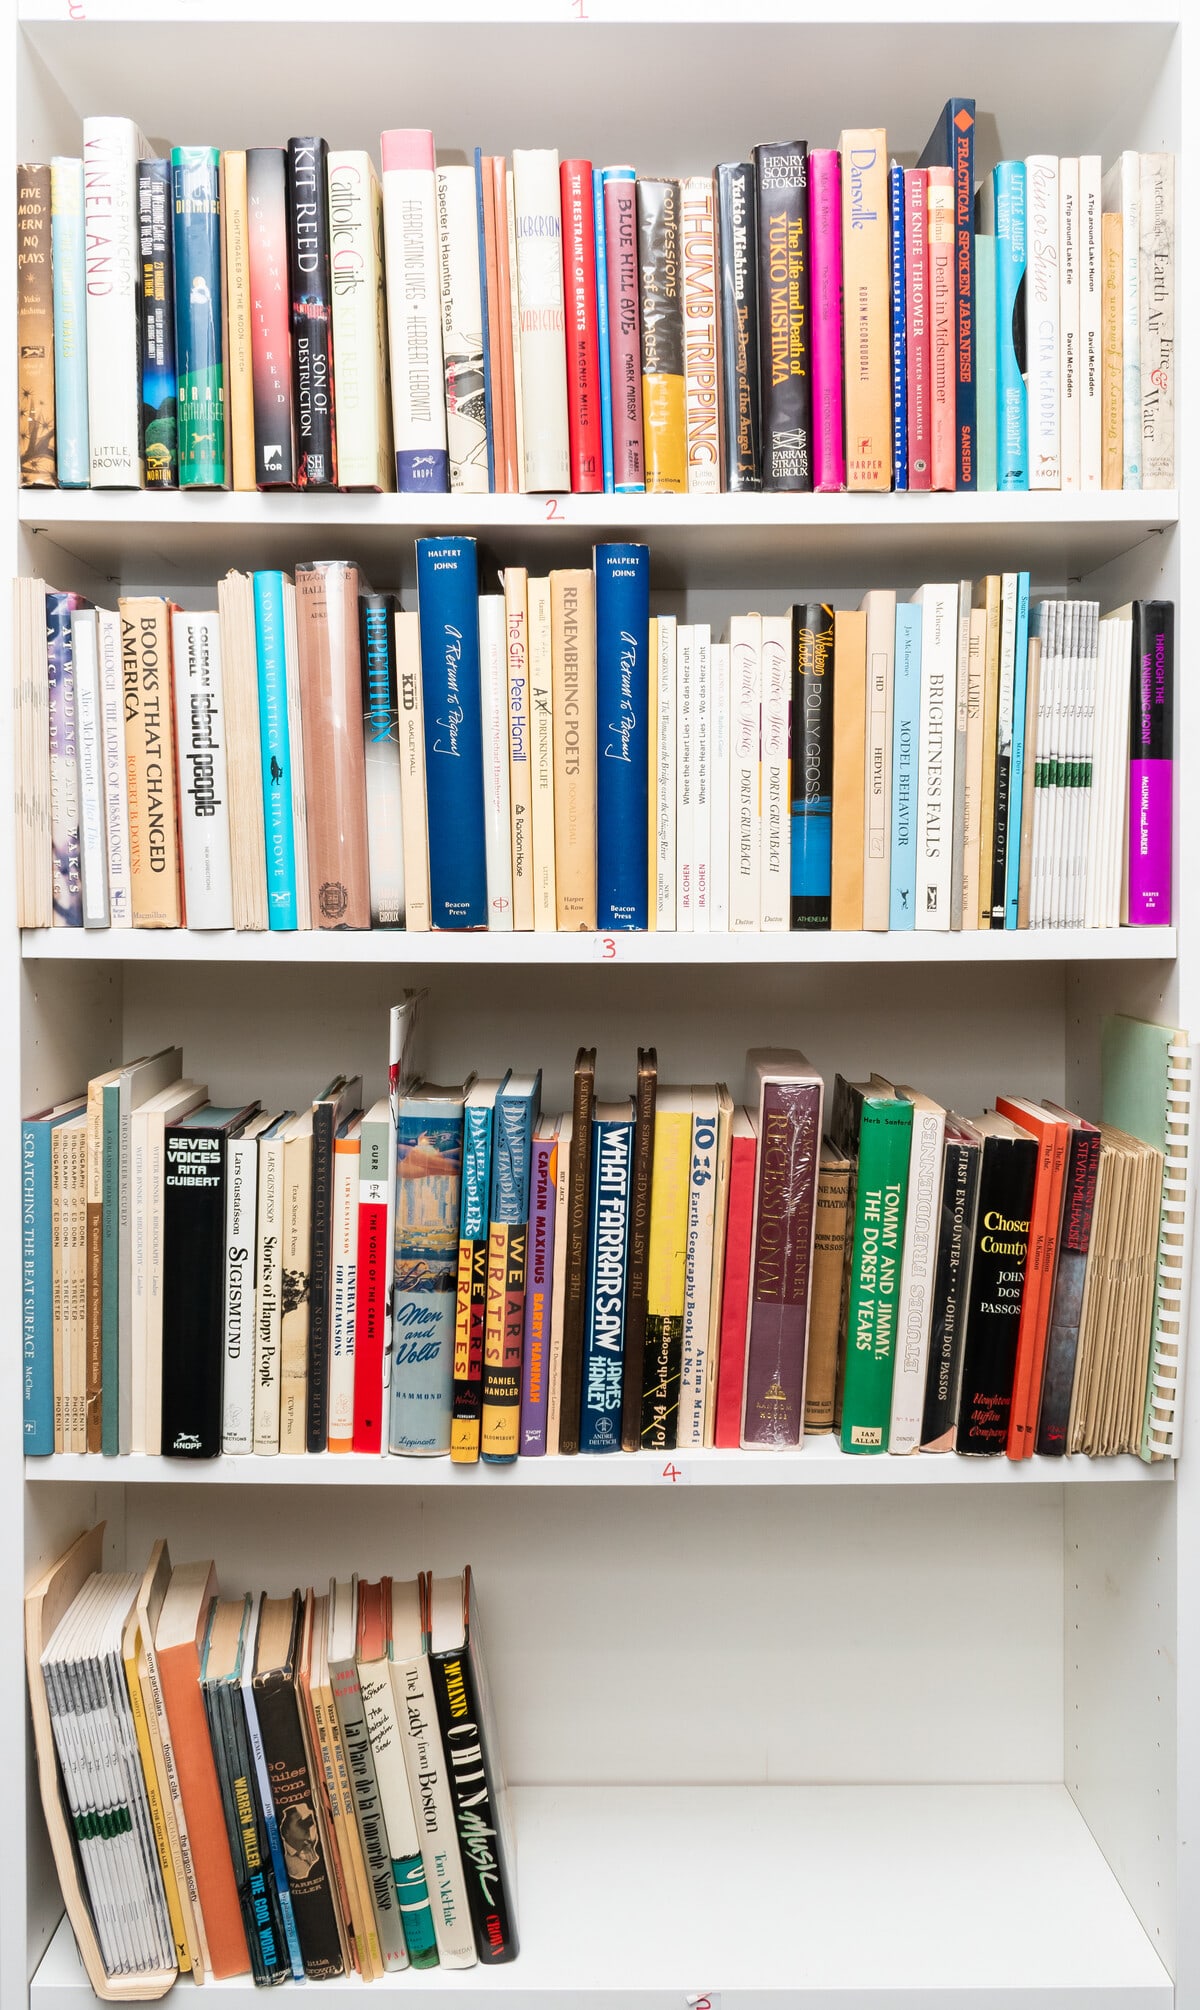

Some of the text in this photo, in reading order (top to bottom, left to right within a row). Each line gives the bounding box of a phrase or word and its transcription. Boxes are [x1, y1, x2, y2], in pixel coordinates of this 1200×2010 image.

[762, 176, 806, 189] STOKES
[763, 155, 804, 168] HENRY
[764, 166, 806, 179] SCOTT-
[851, 148, 878, 230] Dansville
[84, 138, 113, 298] VINELAND
[294, 146, 319, 272] KIT REED
[1087, 200, 1095, 215] Trip
[438, 174, 452, 332] A Specter Is Haunting Texas
[571, 175, 587, 331] THE RESTRAINT OF BEASTS
[912, 179, 924, 337] THE KNIFE THROWER
[957, 137, 971, 383] PRACTICAL SPOKEN JAPANESE
[684, 195, 717, 466] THUMB TRIPPING
[770, 211, 790, 387] YUKIO MISHIMA
[788, 218, 806, 376] The Life and Death of
[298, 337, 313, 437] DESTRUCTION
[312, 353, 328, 415] SON OF
[578, 340, 588, 426] MAGNUS MILLS
[1087, 355, 1095, 397] McFadden
[92, 457, 131, 469] BROWN
[94, 446, 131, 458] LITTLE,
[146, 470, 171, 481] NORTON
[264, 463, 282, 471] TOR
[772, 449, 807, 460] FARRAR
[772, 459, 807, 469] STRAUS
[772, 467, 808, 478] GIROUX
[961, 425, 971, 483] SANSEIDO
[545, 500, 565, 520] 2
[427, 549, 462, 559] HALPERT
[433, 561, 458, 571] JOHNS
[121, 618, 140, 723] AMERICA
[366, 607, 391, 743] REPETITION
[510, 611, 527, 763] The Gift Pete Hamill
[564, 587, 580, 776] REMEMBERING POETS
[1141, 653, 1152, 745] VANISHING POINT
[1155, 633, 1165, 705] THROUGH THE
[141, 617, 166, 873] BOOKS THAT CHANGED
[186, 693, 222, 818] island people
[698, 646, 706, 804] Where the Heart Lies Wo das Herz ruht
[805, 682, 822, 804] POLLY GROSS
[925, 674, 945, 858] BRIGHTNESS FALLS
[739, 769, 752, 876] DORIS GRUMBACH
[897, 719, 912, 847] MODEL BEHAVIOR
[444, 901, 470, 910] Beacon
[449, 909, 467, 918] Press
[698, 863, 706, 908] IRA COHEN
[602, 938, 617, 958] 3
[167, 1152, 221, 1164] VOICES
[167, 1176, 220, 1187] GUIBERT
[168, 1138, 219, 1151] SEVEN
[178, 1164, 207, 1175] RITA
[233, 1151, 244, 1176] Lars
[23, 1132, 35, 1358] SCRATCHING THE BEAT SURFACE
[232, 1177, 243, 1235] Gustafsson
[595, 1126, 629, 1352] WHAT FARRAR SAW
[259, 1236, 278, 1387] Stories of Happy People
[487, 1233, 505, 1359] PIRATES
[505, 1235, 524, 1359] WE ARE
[530, 1151, 548, 1403] CAPTAIN MAXIMUS BARRY HANNAH
[856, 1190, 882, 1351] THE DORSEY YEARS
[874, 1183, 901, 1360] TOMMY AND JIMMY:
[663, 1462, 681, 1482] 4
[147, 1653, 163, 1717] some particulars
[163, 1744, 173, 1773] thomas
[170, 1781, 180, 1801] clark
[405, 1667, 441, 1833] The Lady from Boston
[344, 1720, 393, 1912] La Place de la Concorde Suisse
[180, 1835, 197, 1903] the jargon society
[234, 1776, 277, 1966] WARREN MILLER THE COOL WORLD
[433, 1850, 456, 1927] Tom McHale
